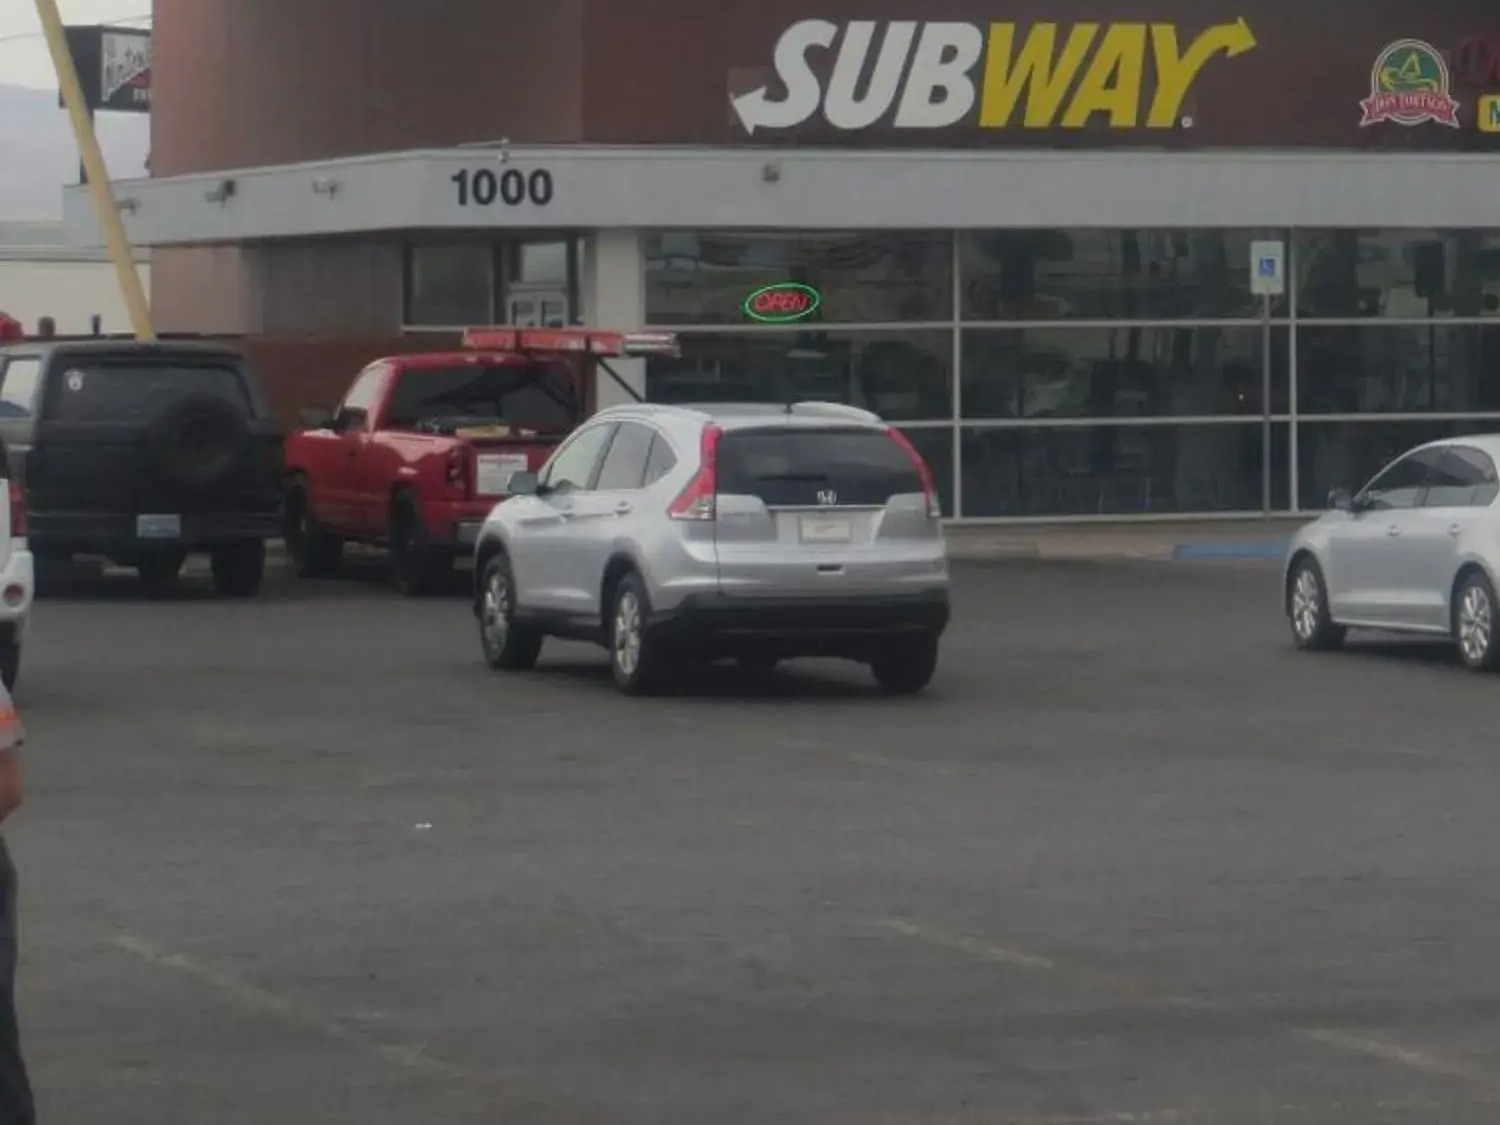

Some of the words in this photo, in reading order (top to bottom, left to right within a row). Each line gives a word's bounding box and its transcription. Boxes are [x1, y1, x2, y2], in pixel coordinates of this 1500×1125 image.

[729, 17, 1256, 135] SUBWAY
[451, 168, 553, 207] 1000
[755, 290, 811, 313] OPEN
